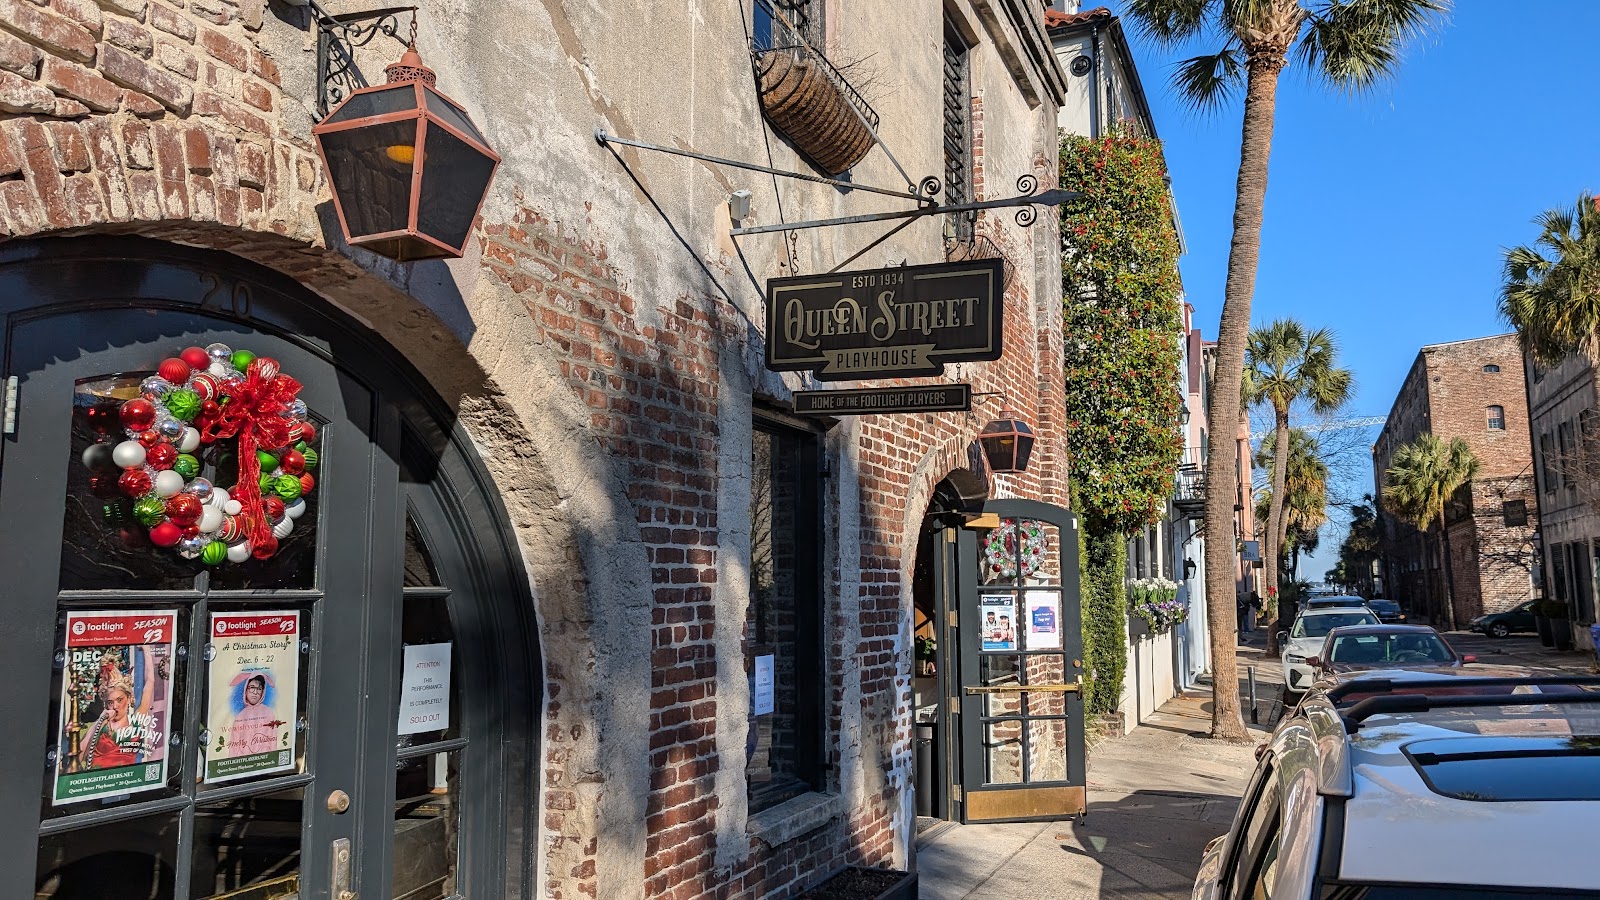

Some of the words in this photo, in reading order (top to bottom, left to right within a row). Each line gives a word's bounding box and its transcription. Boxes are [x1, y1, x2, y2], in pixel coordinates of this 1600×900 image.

[852, 275, 876, 288] ESTD
[880, 272, 904, 286] 1934
[200, 271, 253, 320] 20
[784, 297, 868, 350] QUEEN
[871, 290, 980, 342] STREET
[837, 350, 917, 369] PLAYHOUSE
[811, 397, 834, 409] HOME
[836, 397, 845, 407] OF
[846, 397, 858, 407] THE
[860, 393, 906, 408] FOOTLIGHT
[907, 391, 946, 406] PLAYERS
[88, 620, 124, 632] footlight
[132, 618, 168, 630] SEASON
[228, 620, 256, 630] footlight
[260, 617, 282, 626] SEASON
[280, 620, 295, 633] 93
[144, 628, 163, 644] 93
[223, 643, 230, 651] A
[233, 642, 267, 650] Christmas
[270, 641, 288, 650] Story
[72, 651, 102, 662] DEC
[411, 684, 443, 692] PERFORMANCE
[415, 698, 442, 706] COMPLETELY
[128, 712, 158, 728] WHO'S
[410, 715, 427, 724] SOLD
[116, 726, 162, 744] HOLIDAY!
[70, 771, 134, 786] FOOTLIGHTPLAYERS.NET
